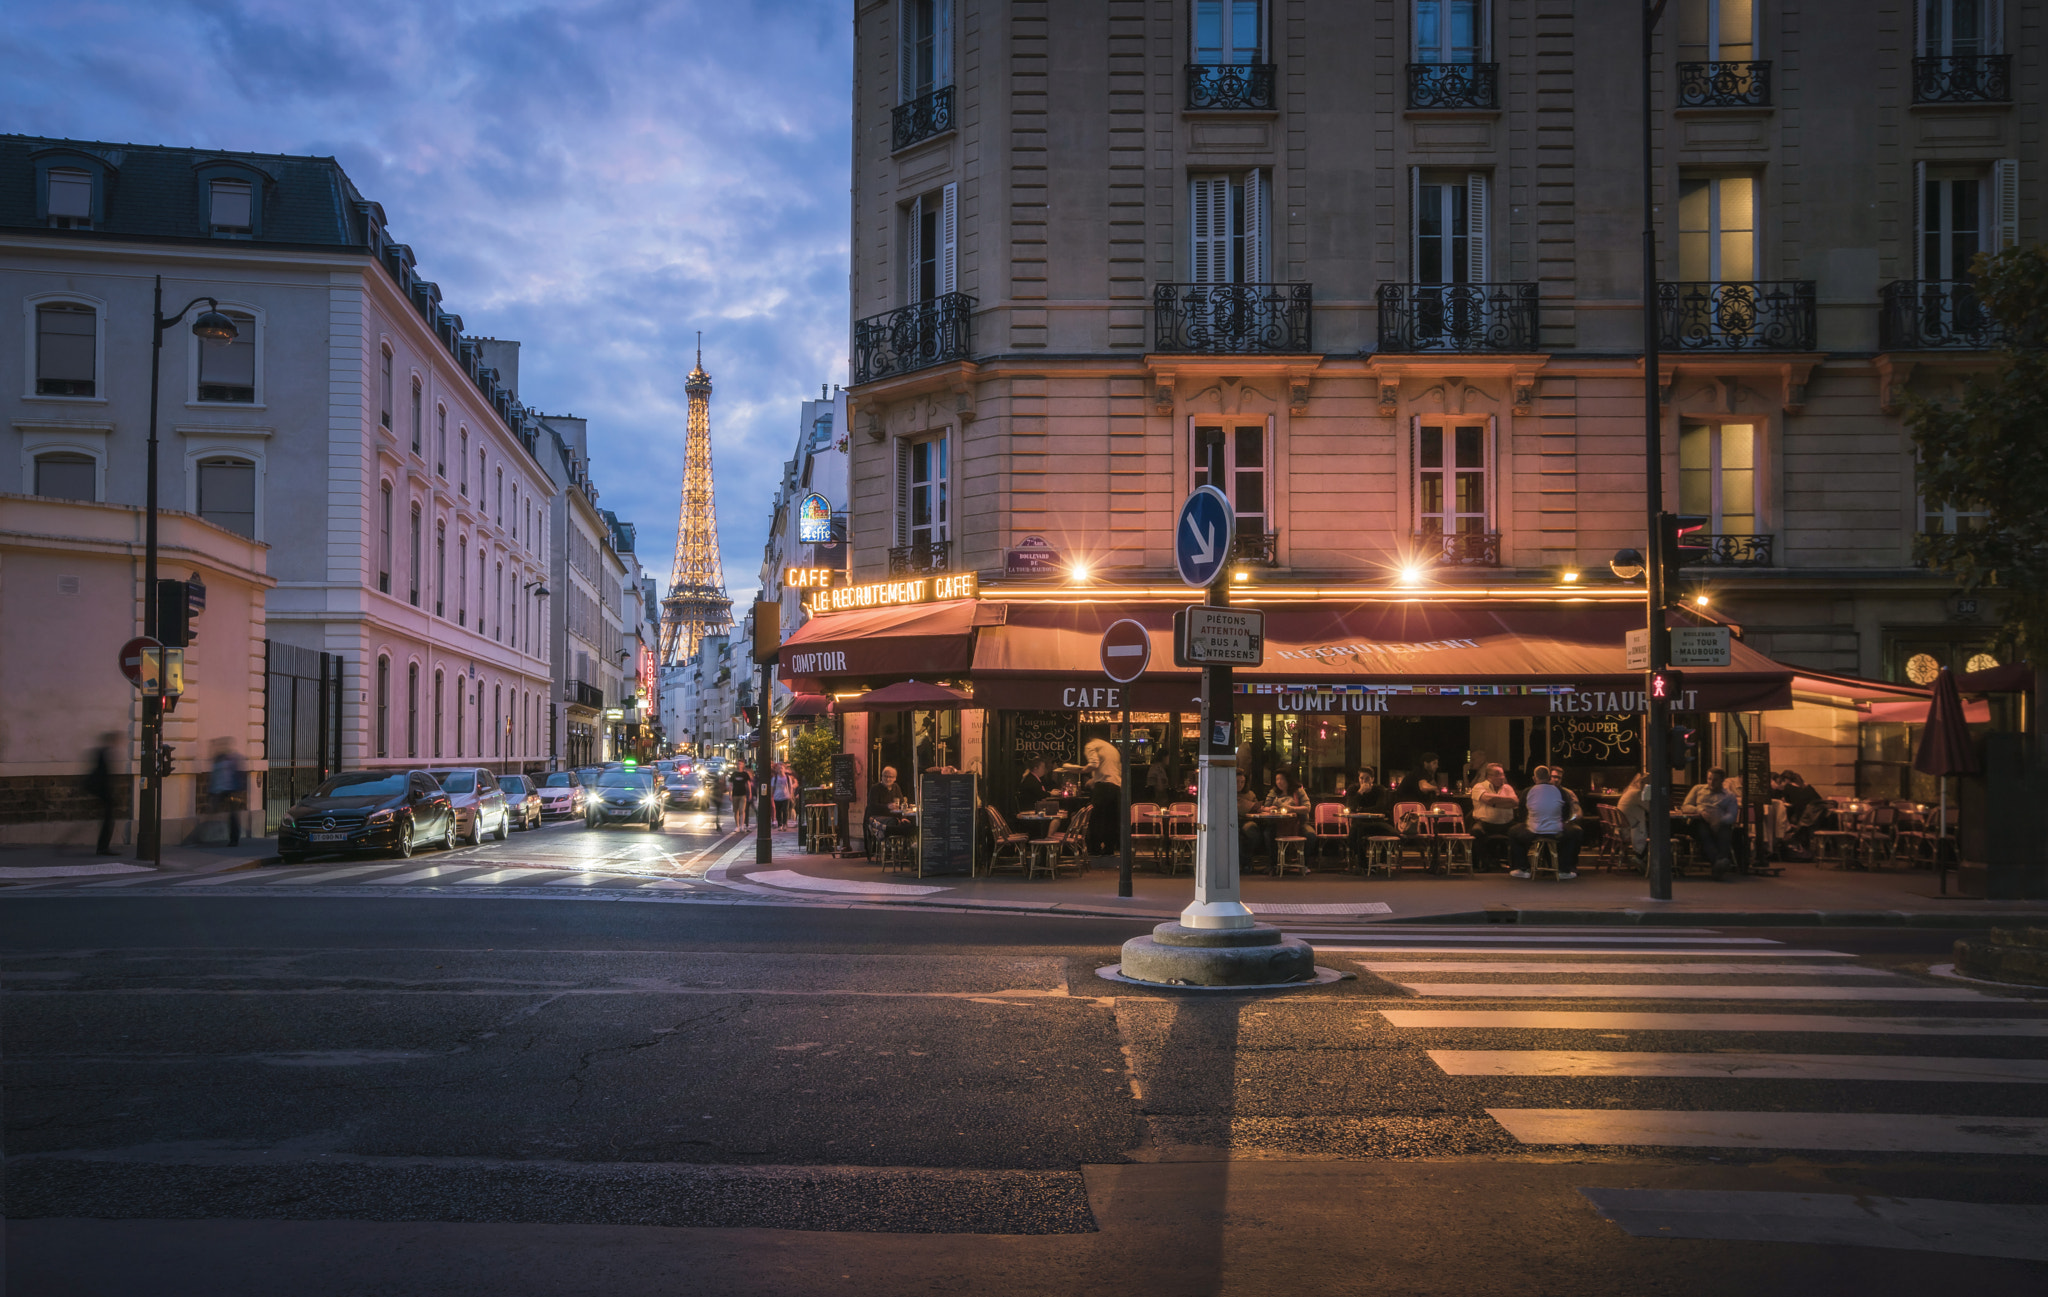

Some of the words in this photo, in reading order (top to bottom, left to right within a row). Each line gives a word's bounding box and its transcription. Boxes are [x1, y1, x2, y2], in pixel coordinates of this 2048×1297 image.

[801, 526, 831, 540] Leffe
[789, 569, 830, 587] CAFE
[813, 591, 830, 612] LE
[833, 580, 926, 608] RECRUTEMENT
[936, 575, 974, 599] CAFE
[1206, 614, 1246, 626] PIÉTONS
[1200, 626, 1250, 637] ATTENTION
[1211, 638, 1229, 647] BUS
[1275, 638, 1482, 660] RECRUTEMENT
[1697, 638, 1718, 646] TOUR
[1204, 648, 1255, 660] NTRESENS
[792, 651, 847, 673] COMPTOIR
[1063, 687, 1120, 708] CAFE
[1277, 691, 1389, 712] COMPTOIR
[1550, 690, 1698, 712] RESTAURNT
[1567, 718, 1619, 733] SOUPER
[1015, 737, 1065, 751] BRUNCH
